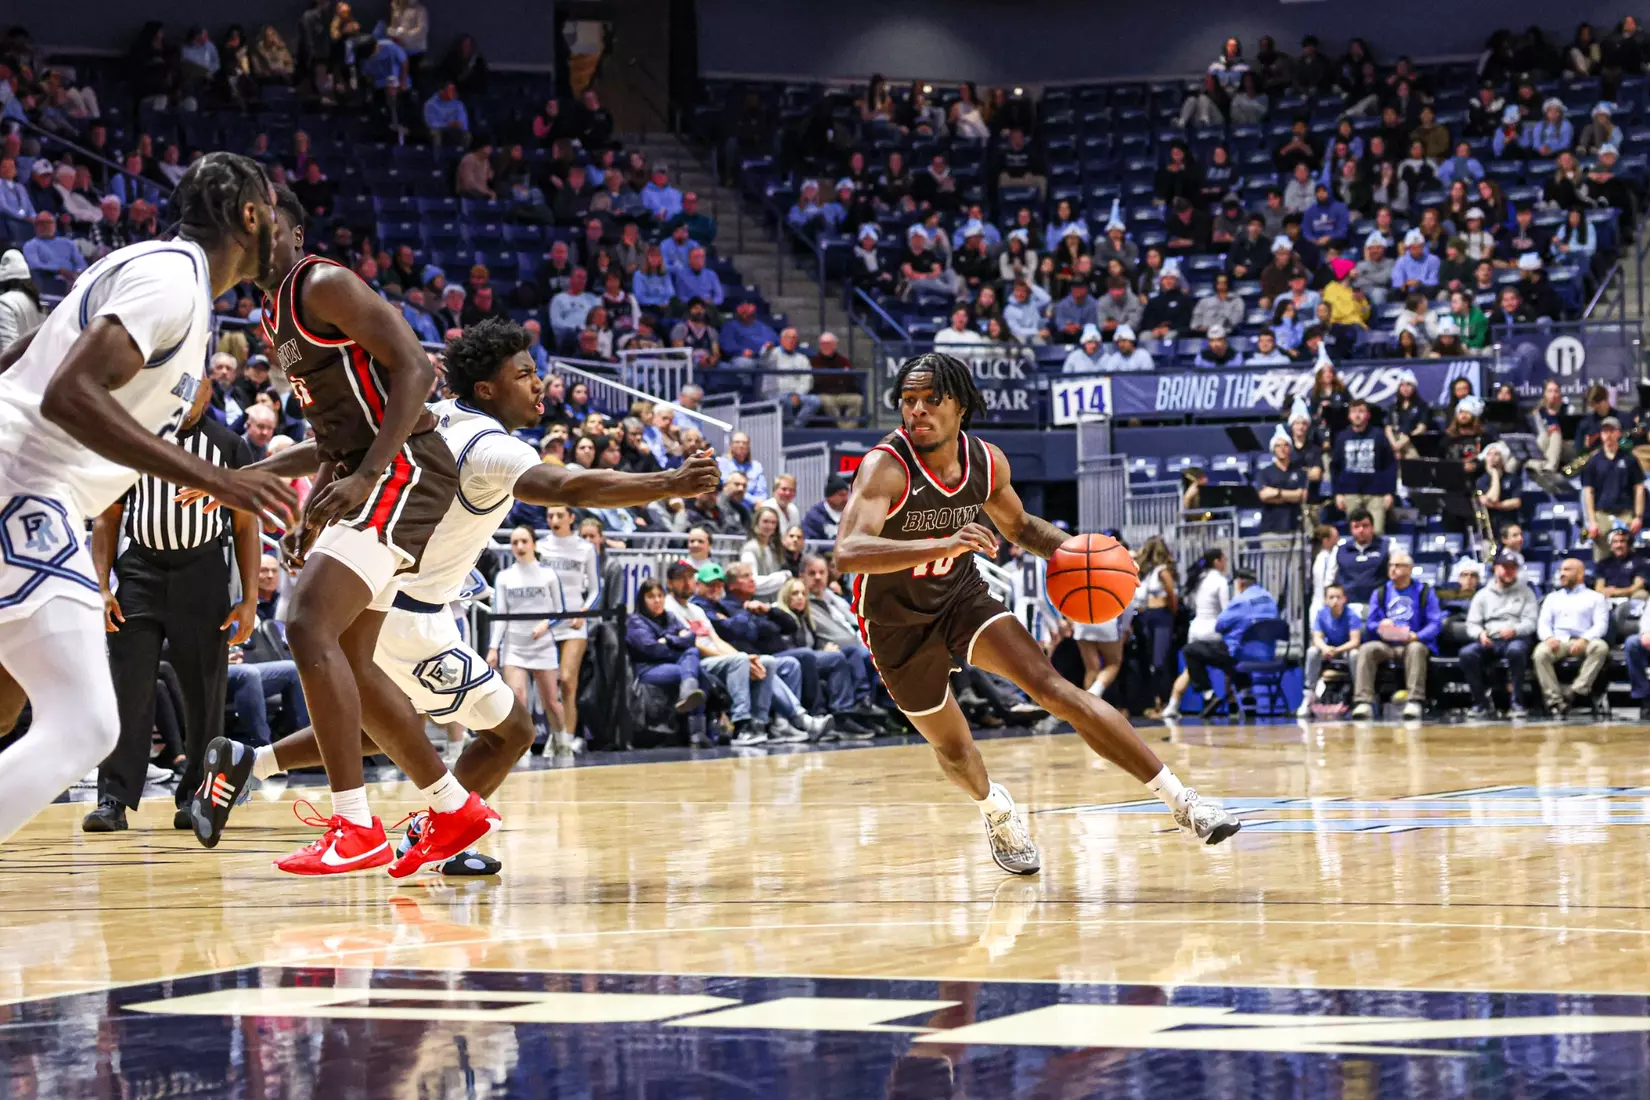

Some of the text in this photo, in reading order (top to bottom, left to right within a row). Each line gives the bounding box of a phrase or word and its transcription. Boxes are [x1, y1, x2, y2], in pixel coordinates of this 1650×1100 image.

[981, 388, 1030, 411] BAR
[1058, 385, 1106, 417] 114
[1155, 373, 1220, 411] BRING
